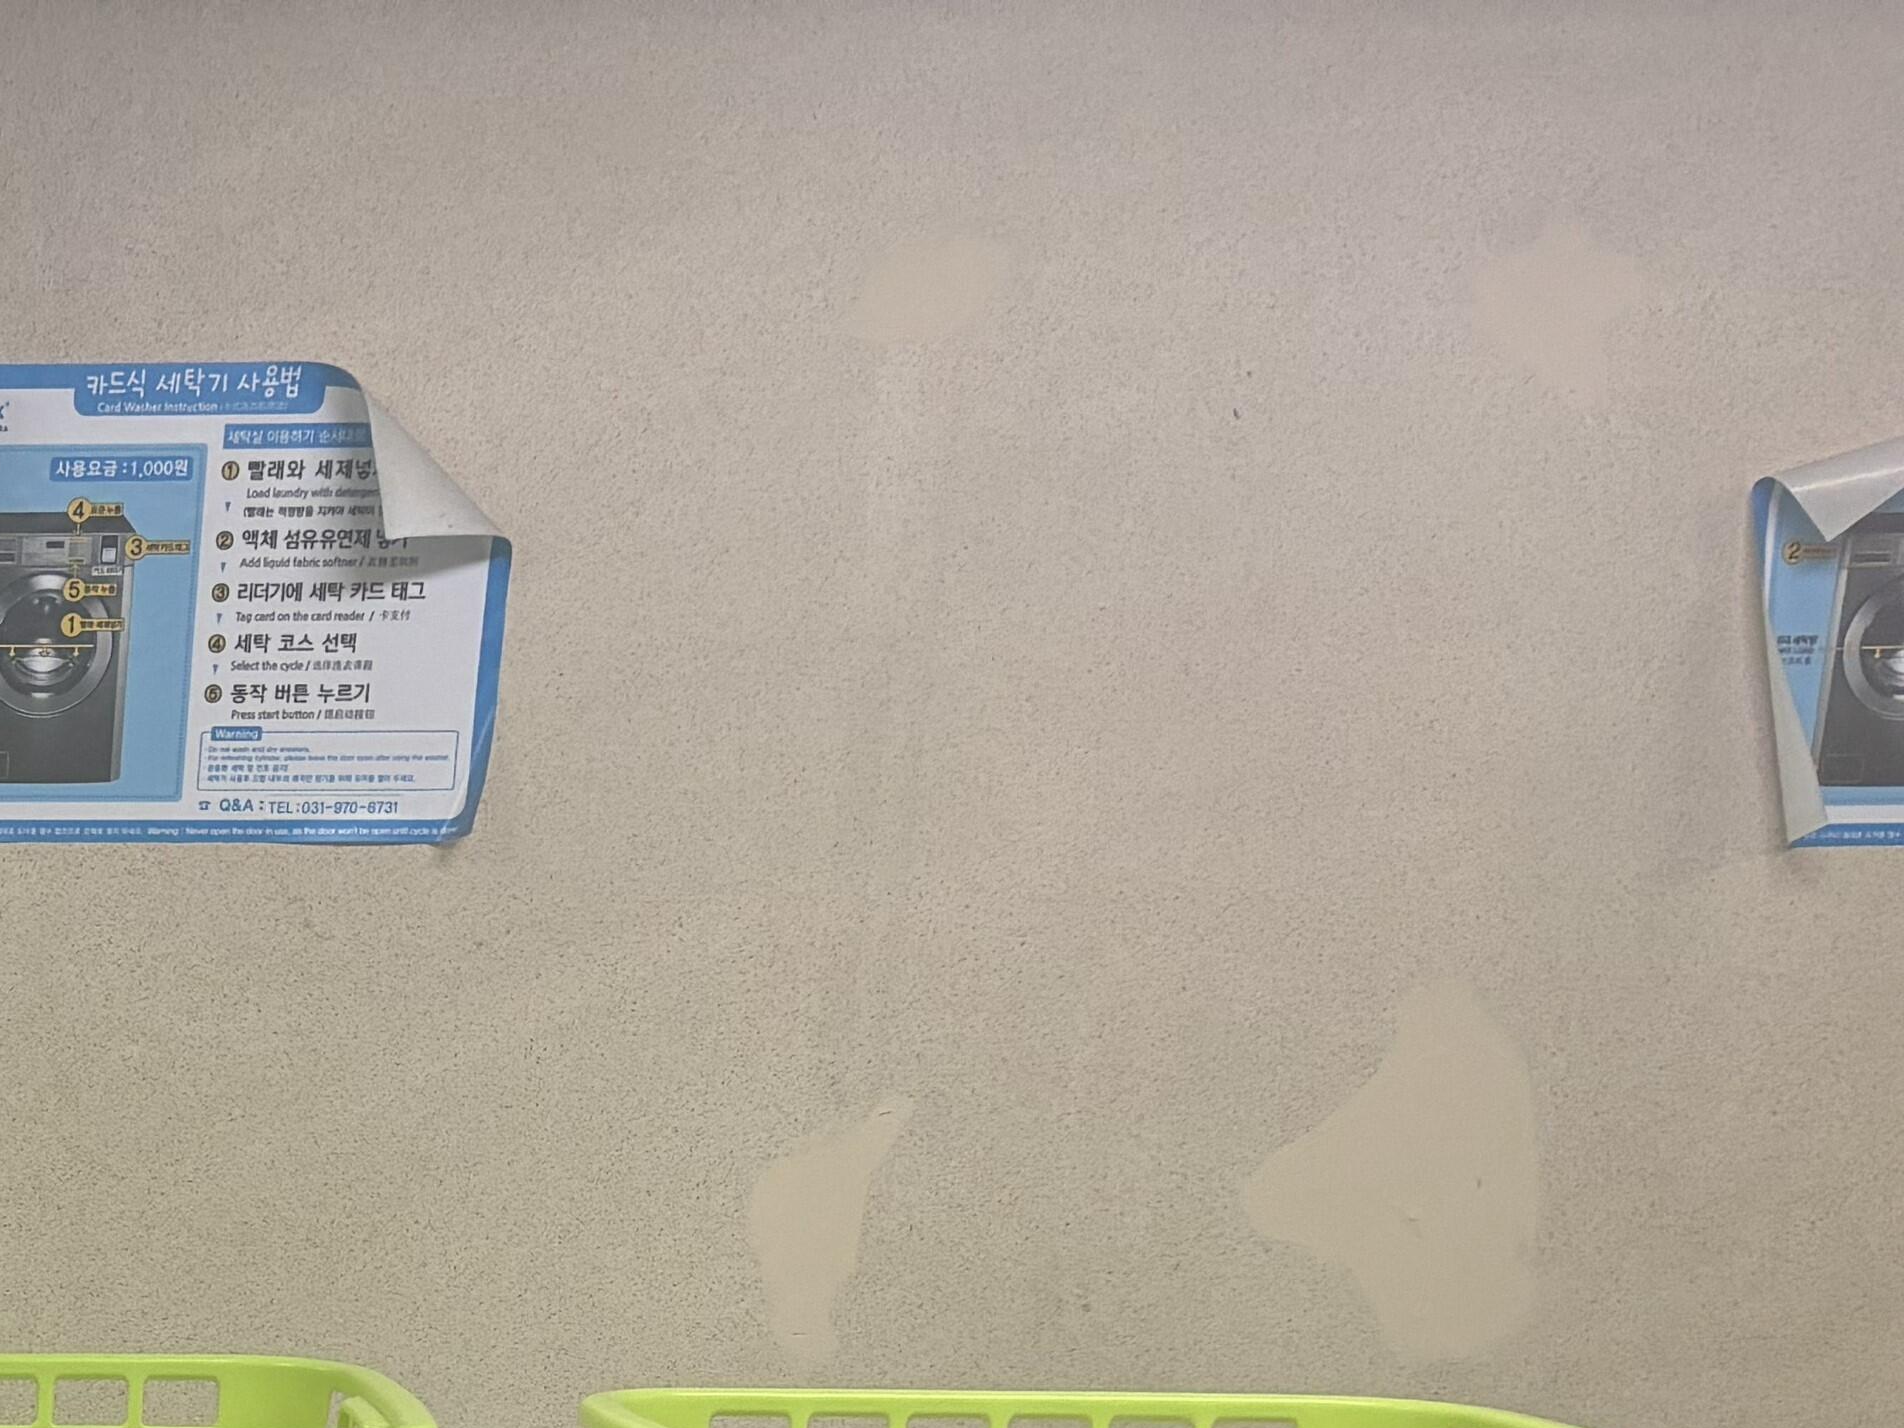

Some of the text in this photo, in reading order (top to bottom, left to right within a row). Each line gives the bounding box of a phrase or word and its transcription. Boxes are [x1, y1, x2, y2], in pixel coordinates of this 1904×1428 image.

[86, 365, 302, 399] 카드식 세탁기 사용법
[246, 458, 379, 483] 빨래와 세제넣
[245, 487, 273, 501] Load
[271, 487, 311, 501] laundry
[70, 498, 87, 523] 4
[128, 538, 145, 559] 3
[240, 529, 374, 552] 액체 섬유유연제
[238, 556, 263, 571] Add
[261, 556, 293, 571] liquid
[291, 556, 323, 570] fabric
[67, 580, 83, 601] 5
[237, 581, 426, 603] 리더기에 세탁 카드 태그
[65, 615, 80, 636] 1
[235, 609, 366, 624] Tag card on the card reader
[234, 632, 357, 654] 세탁 코스 선택
[230, 660, 305, 673] Select the cycle
[230, 682, 370, 704] 동작 버튼 누르기
[230, 708, 315, 720] Press start button
[215, 728, 261, 742] Warning
[219, 797, 254, 812] Q&A
